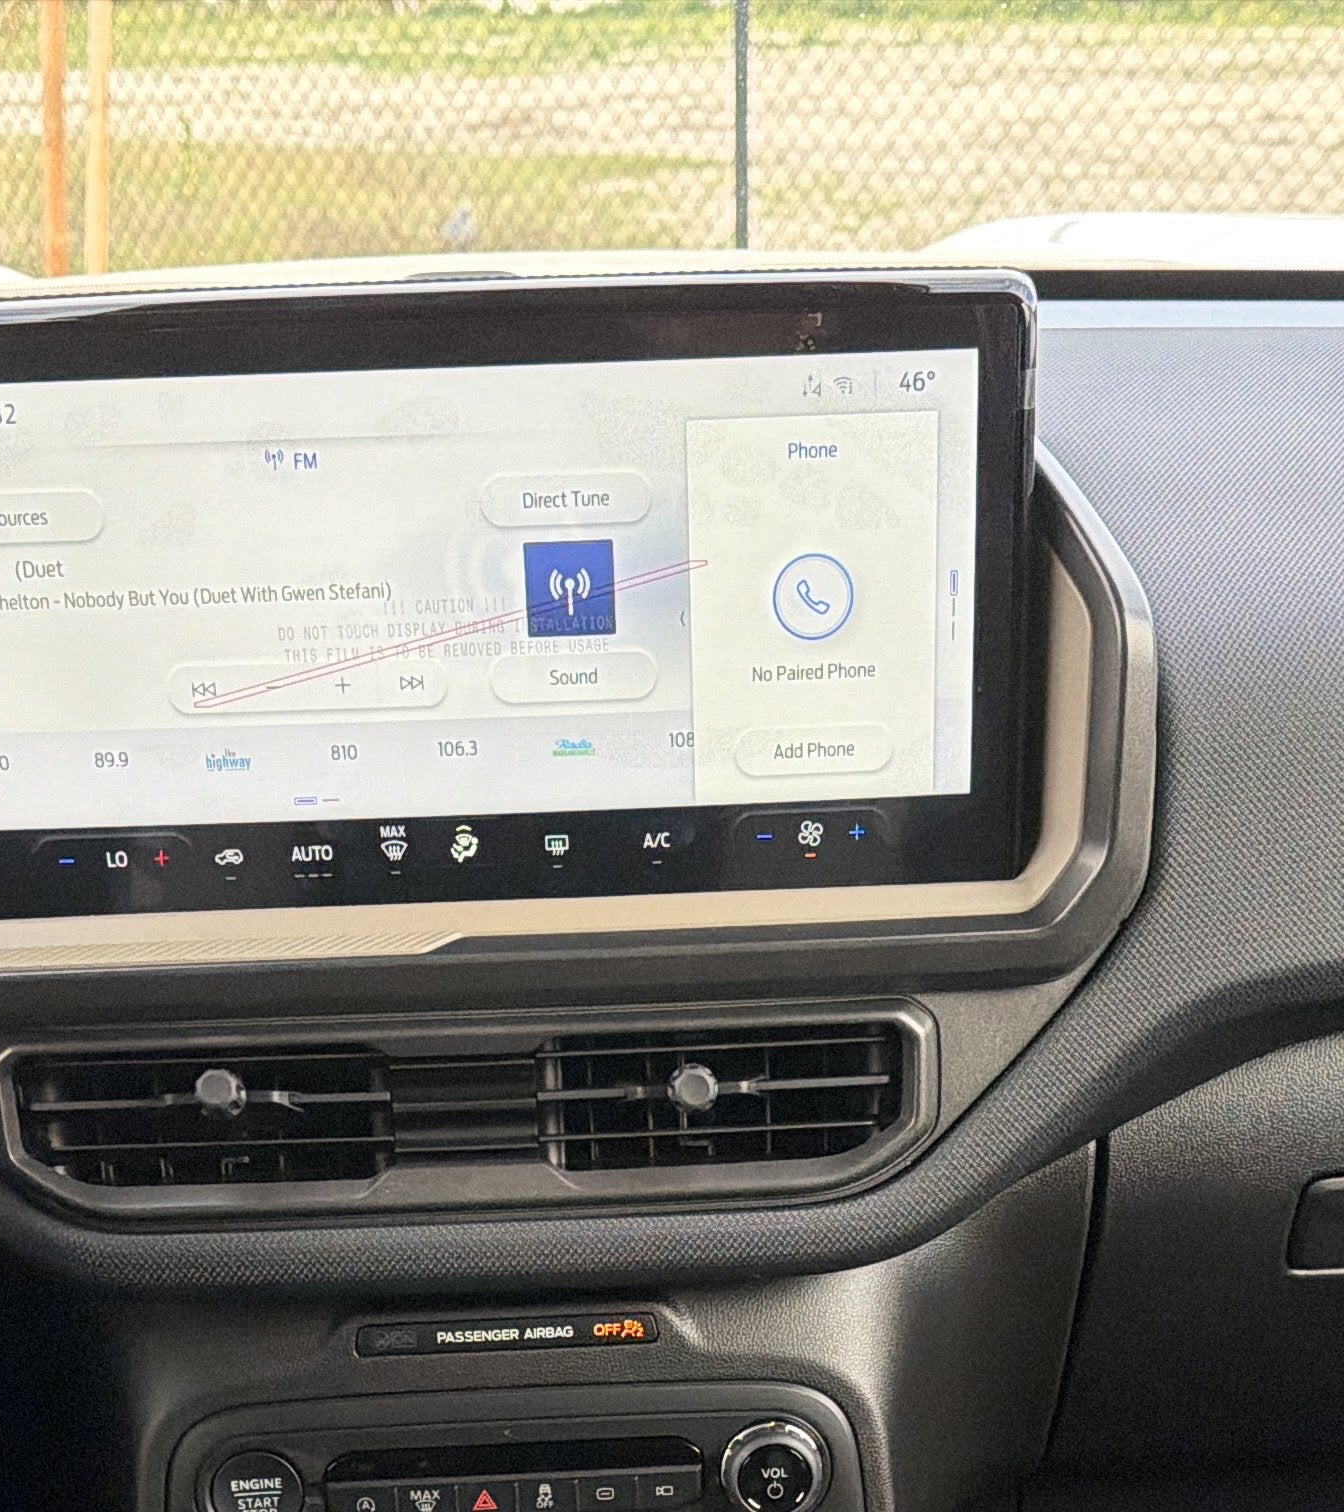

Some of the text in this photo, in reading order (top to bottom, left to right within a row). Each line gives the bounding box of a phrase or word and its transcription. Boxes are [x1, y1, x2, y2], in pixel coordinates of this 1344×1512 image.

[787, 440, 838, 460] Phone
[293, 452, 319, 470] FM
[522, 489, 610, 509] Direct Tune
[15, 559, 65, 583] (Duet
[64, 588, 125, 611] Nobody
[128, 588, 156, 608] But
[158, 587, 190, 607] You
[193, 585, 237, 609] (Duet
[239, 584, 278, 604] With
[281, 585, 326, 602] Gwen
[329, 582, 392, 602] Stefani)
[416, 598, 475, 615] CAUTION
[278, 626, 295, 641] DO
[304, 625, 328, 640] NOT
[338, 623, 379, 639] TOUCH
[387, 621, 446, 638] DISPLAY
[285, 649, 318, 663] THIS
[418, 644, 435, 658] BE
[444, 642, 502, 657] REMOVED
[510, 640, 560, 655] BEFORE
[568, 638, 609, 653] USAGE
[549, 667, 599, 686] Sound
[752, 660, 876, 682] No Paired Phone
[331, 744, 358, 761] 810
[437, 739, 479, 758] 106.3
[773, 739, 855, 760] Add Phone
[94, 751, 129, 770] 89.9
[205, 753, 251, 771] highway
[380, 825, 406, 839] MAX
[642, 832, 671, 850] A/C
[106, 851, 128, 869] LO
[291, 845, 334, 863] AUTO
[436, 1325, 574, 1344] PASSENGER AIRBAG
[593, 1323, 622, 1337] OFF
[761, 1467, 789, 1479] VOL
[230, 1477, 282, 1492] ENGINE
[238, 1497, 280, 1510] START
[410, 1489, 441, 1501] MAX
[536, 1499, 555, 1509] OFF
